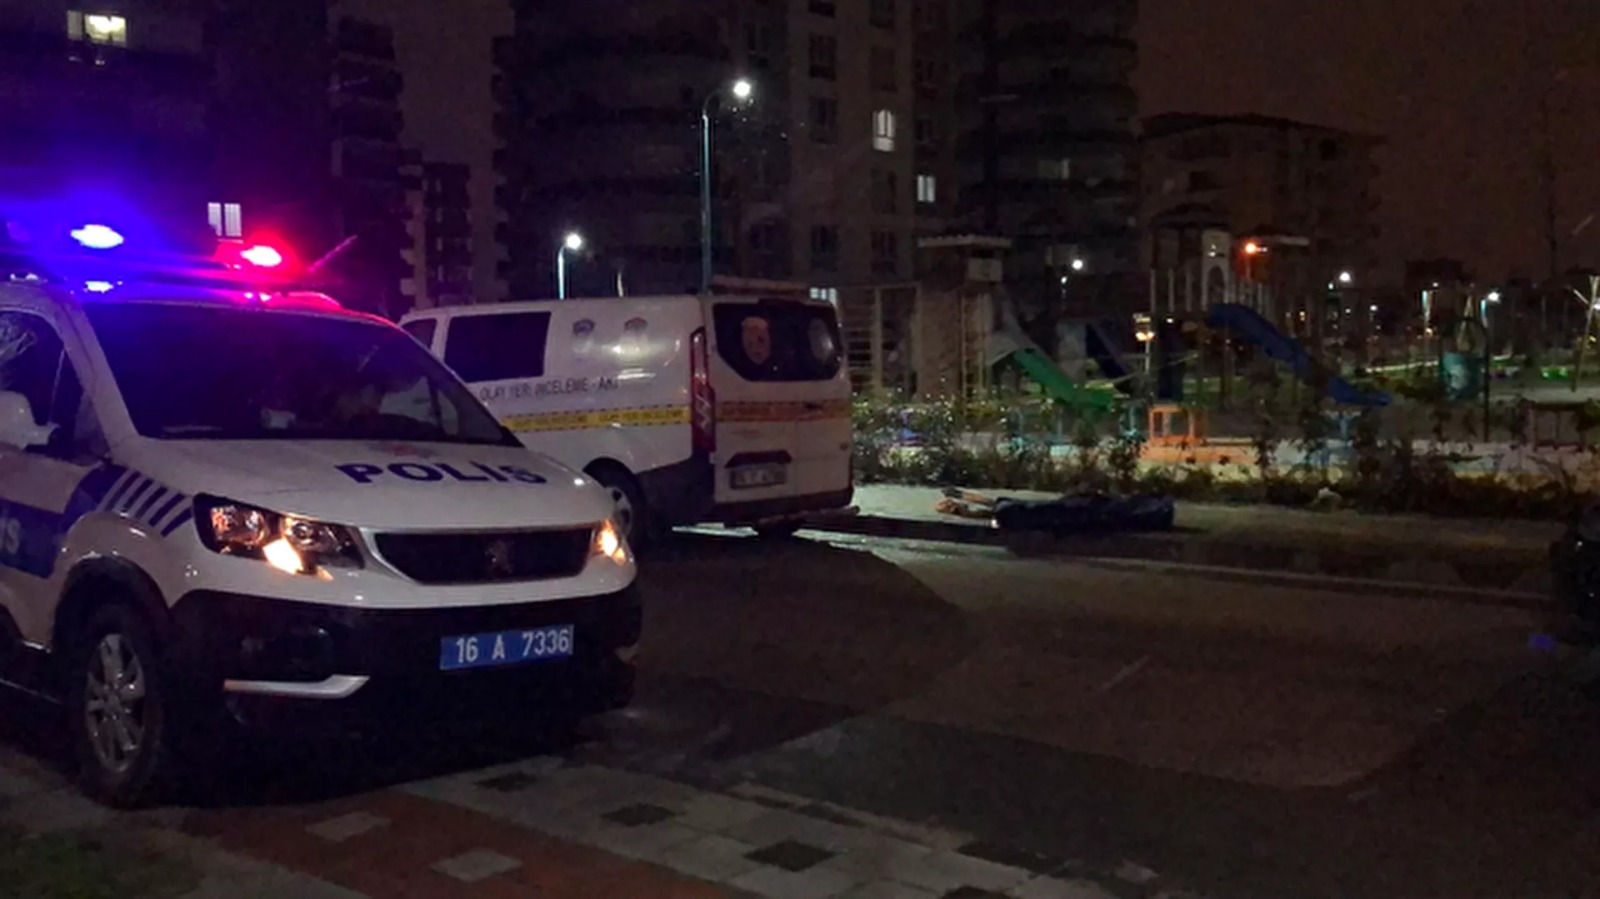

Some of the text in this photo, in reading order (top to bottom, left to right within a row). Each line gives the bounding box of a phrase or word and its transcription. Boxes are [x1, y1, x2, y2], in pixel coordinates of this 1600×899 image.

[456, 628, 570, 663] 16 A 7336
